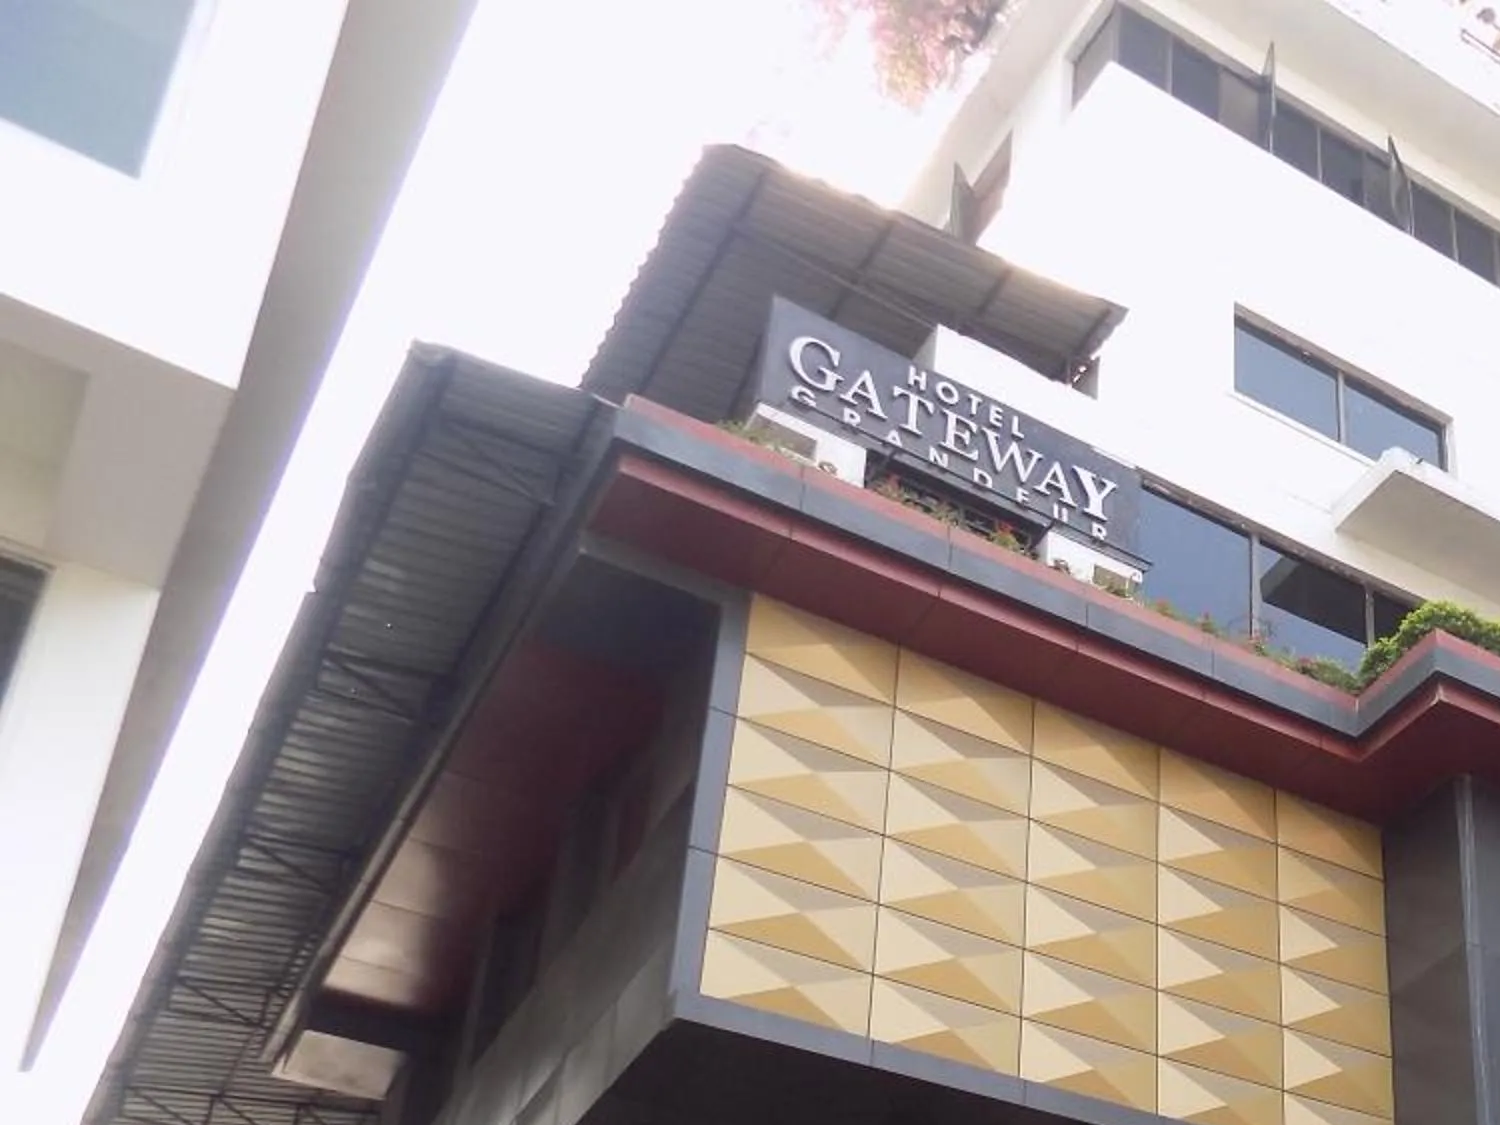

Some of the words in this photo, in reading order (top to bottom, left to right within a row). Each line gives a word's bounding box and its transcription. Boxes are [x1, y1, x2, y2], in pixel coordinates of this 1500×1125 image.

[788, 336, 1117, 522] GATEWAY
[791, 386, 1107, 541] GRANDEUR
[908, 365, 1024, 439] HOTEL
